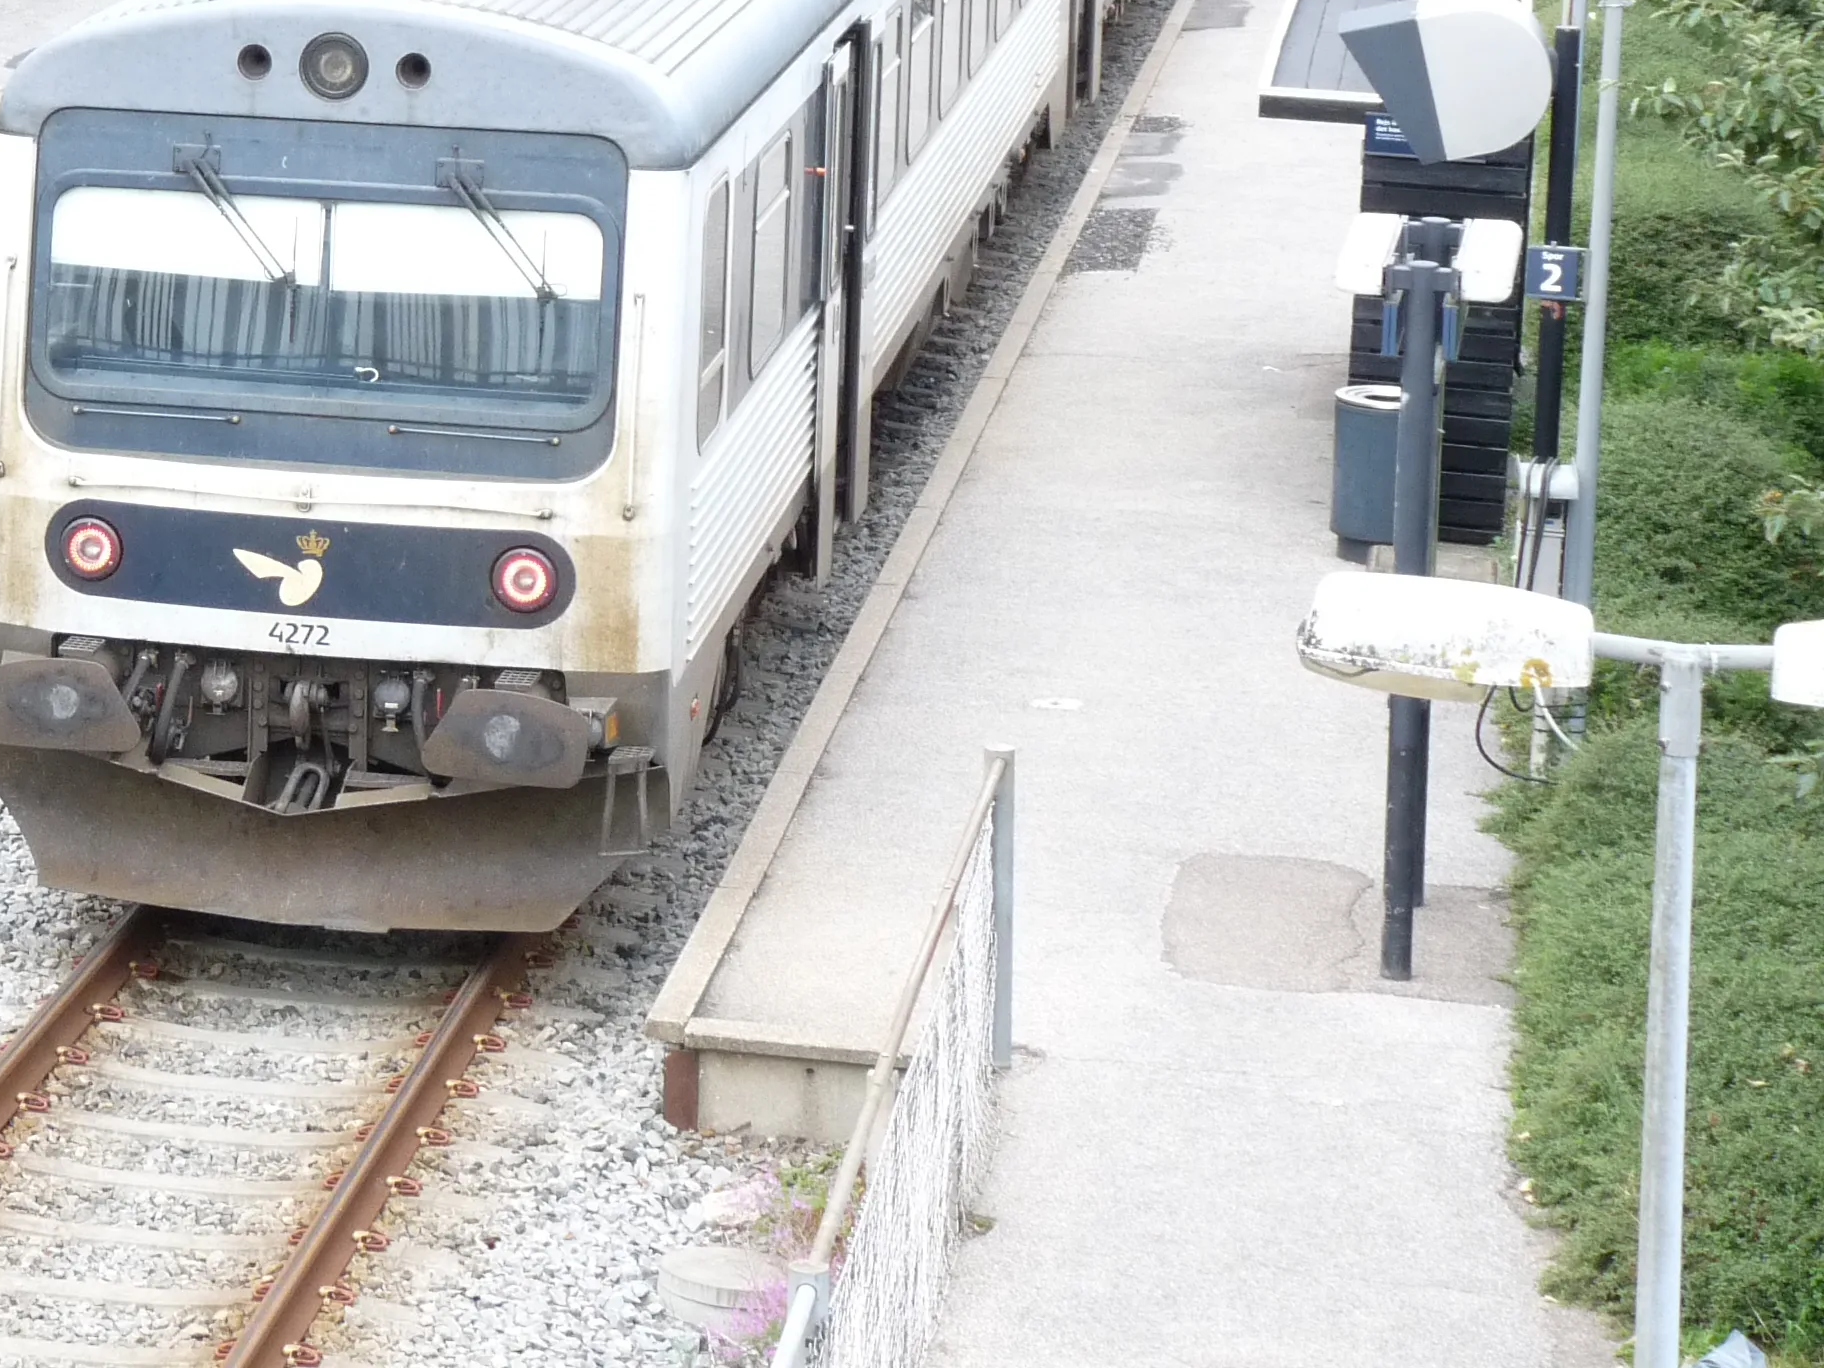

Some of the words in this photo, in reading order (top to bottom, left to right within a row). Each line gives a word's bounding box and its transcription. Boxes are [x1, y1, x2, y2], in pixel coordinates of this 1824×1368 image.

[1541, 251, 1565, 261] Spor
[1540, 263, 1563, 292] 2
[268, 622, 331, 646] 4272
